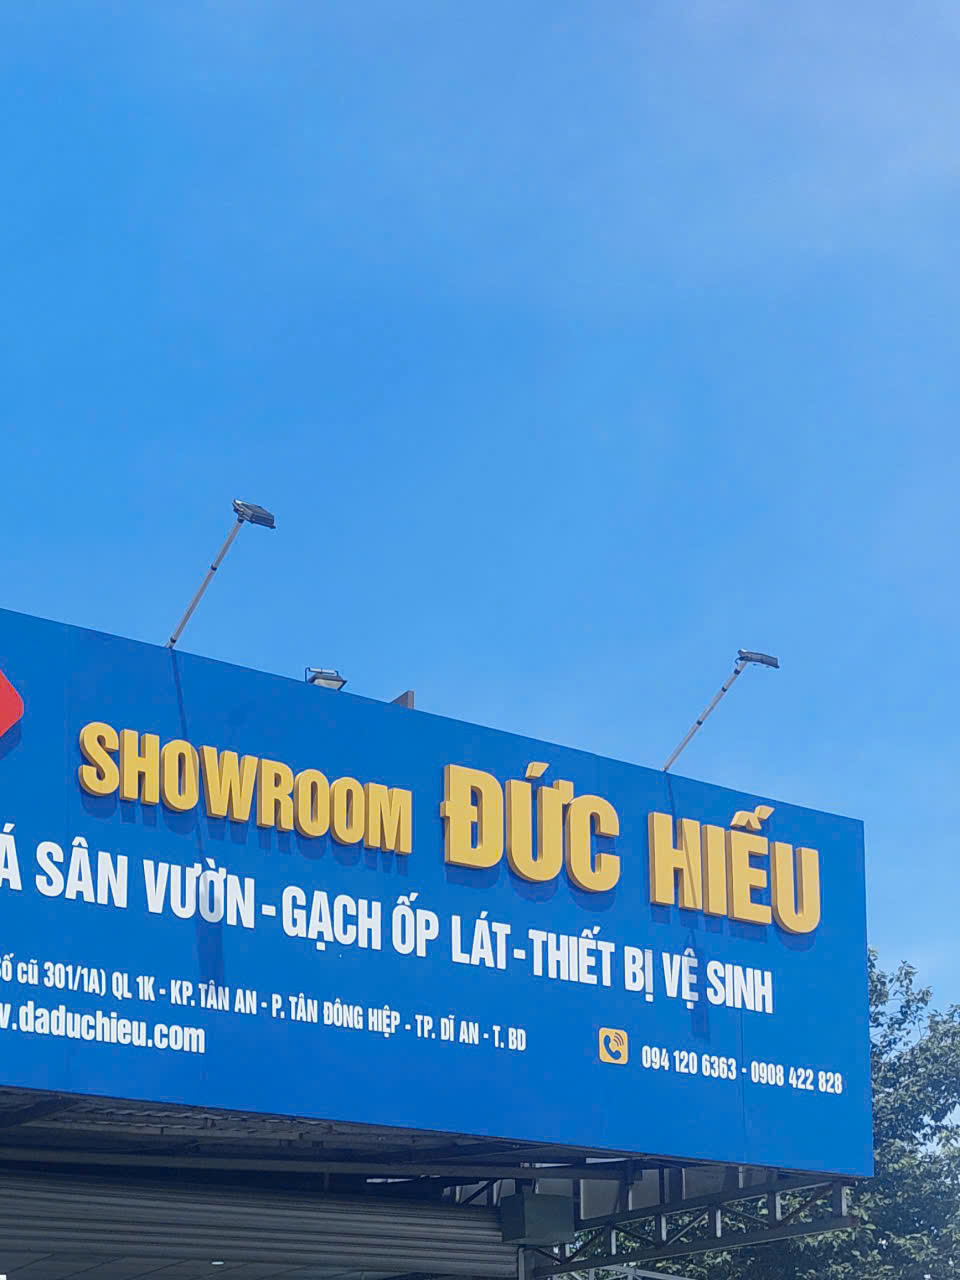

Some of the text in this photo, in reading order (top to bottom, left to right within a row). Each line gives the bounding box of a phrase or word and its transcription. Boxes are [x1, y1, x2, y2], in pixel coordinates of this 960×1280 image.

[79, 721, 821, 934] SHOWROOM ĐỨC HIẾU
[36, 836, 128, 908] SÂN
[143, 857, 255, 929] VƯỜN
[282, 884, 381, 951] GẠCH
[391, 892, 439, 957] ỐP
[451, 910, 511, 972] LÁT
[528, 925, 615, 987] THIẾT
[624, 946, 654, 1003] BỊ
[662, 946, 699, 1010] VỆ
[706, 961, 774, 1014] SINH
[17, 958, 39, 985] cũ
[43, 961, 107, 997] 301/1A)
[112, 971, 133, 1001] QL
[136, 974, 156, 1002] 1K
[198, 979, 230, 1012] TÂN
[234, 987, 257, 1015] AN
[271, 993, 285, 1019] P.
[289, 991, 318, 1024] TÂN
[323, 997, 364, 1031] ĐÔNG
[367, 1004, 401, 1038] HIỆP
[415, 1013, 436, 1040] TP.
[440, 1013, 455, 1042] DĨ
[458, 1019, 479, 1046] AN
[492, 1024, 505, 1049] T.
[508, 1027, 527, 1052] BD
[641, 1045, 670, 1072] 094
[673, 1049, 698, 1075] 120
[701, 1054, 737, 1081] 6363
[751, 1060, 785, 1087] 0908
[789, 1066, 815, 1091] 422
[818, 1070, 843, 1095] 828
